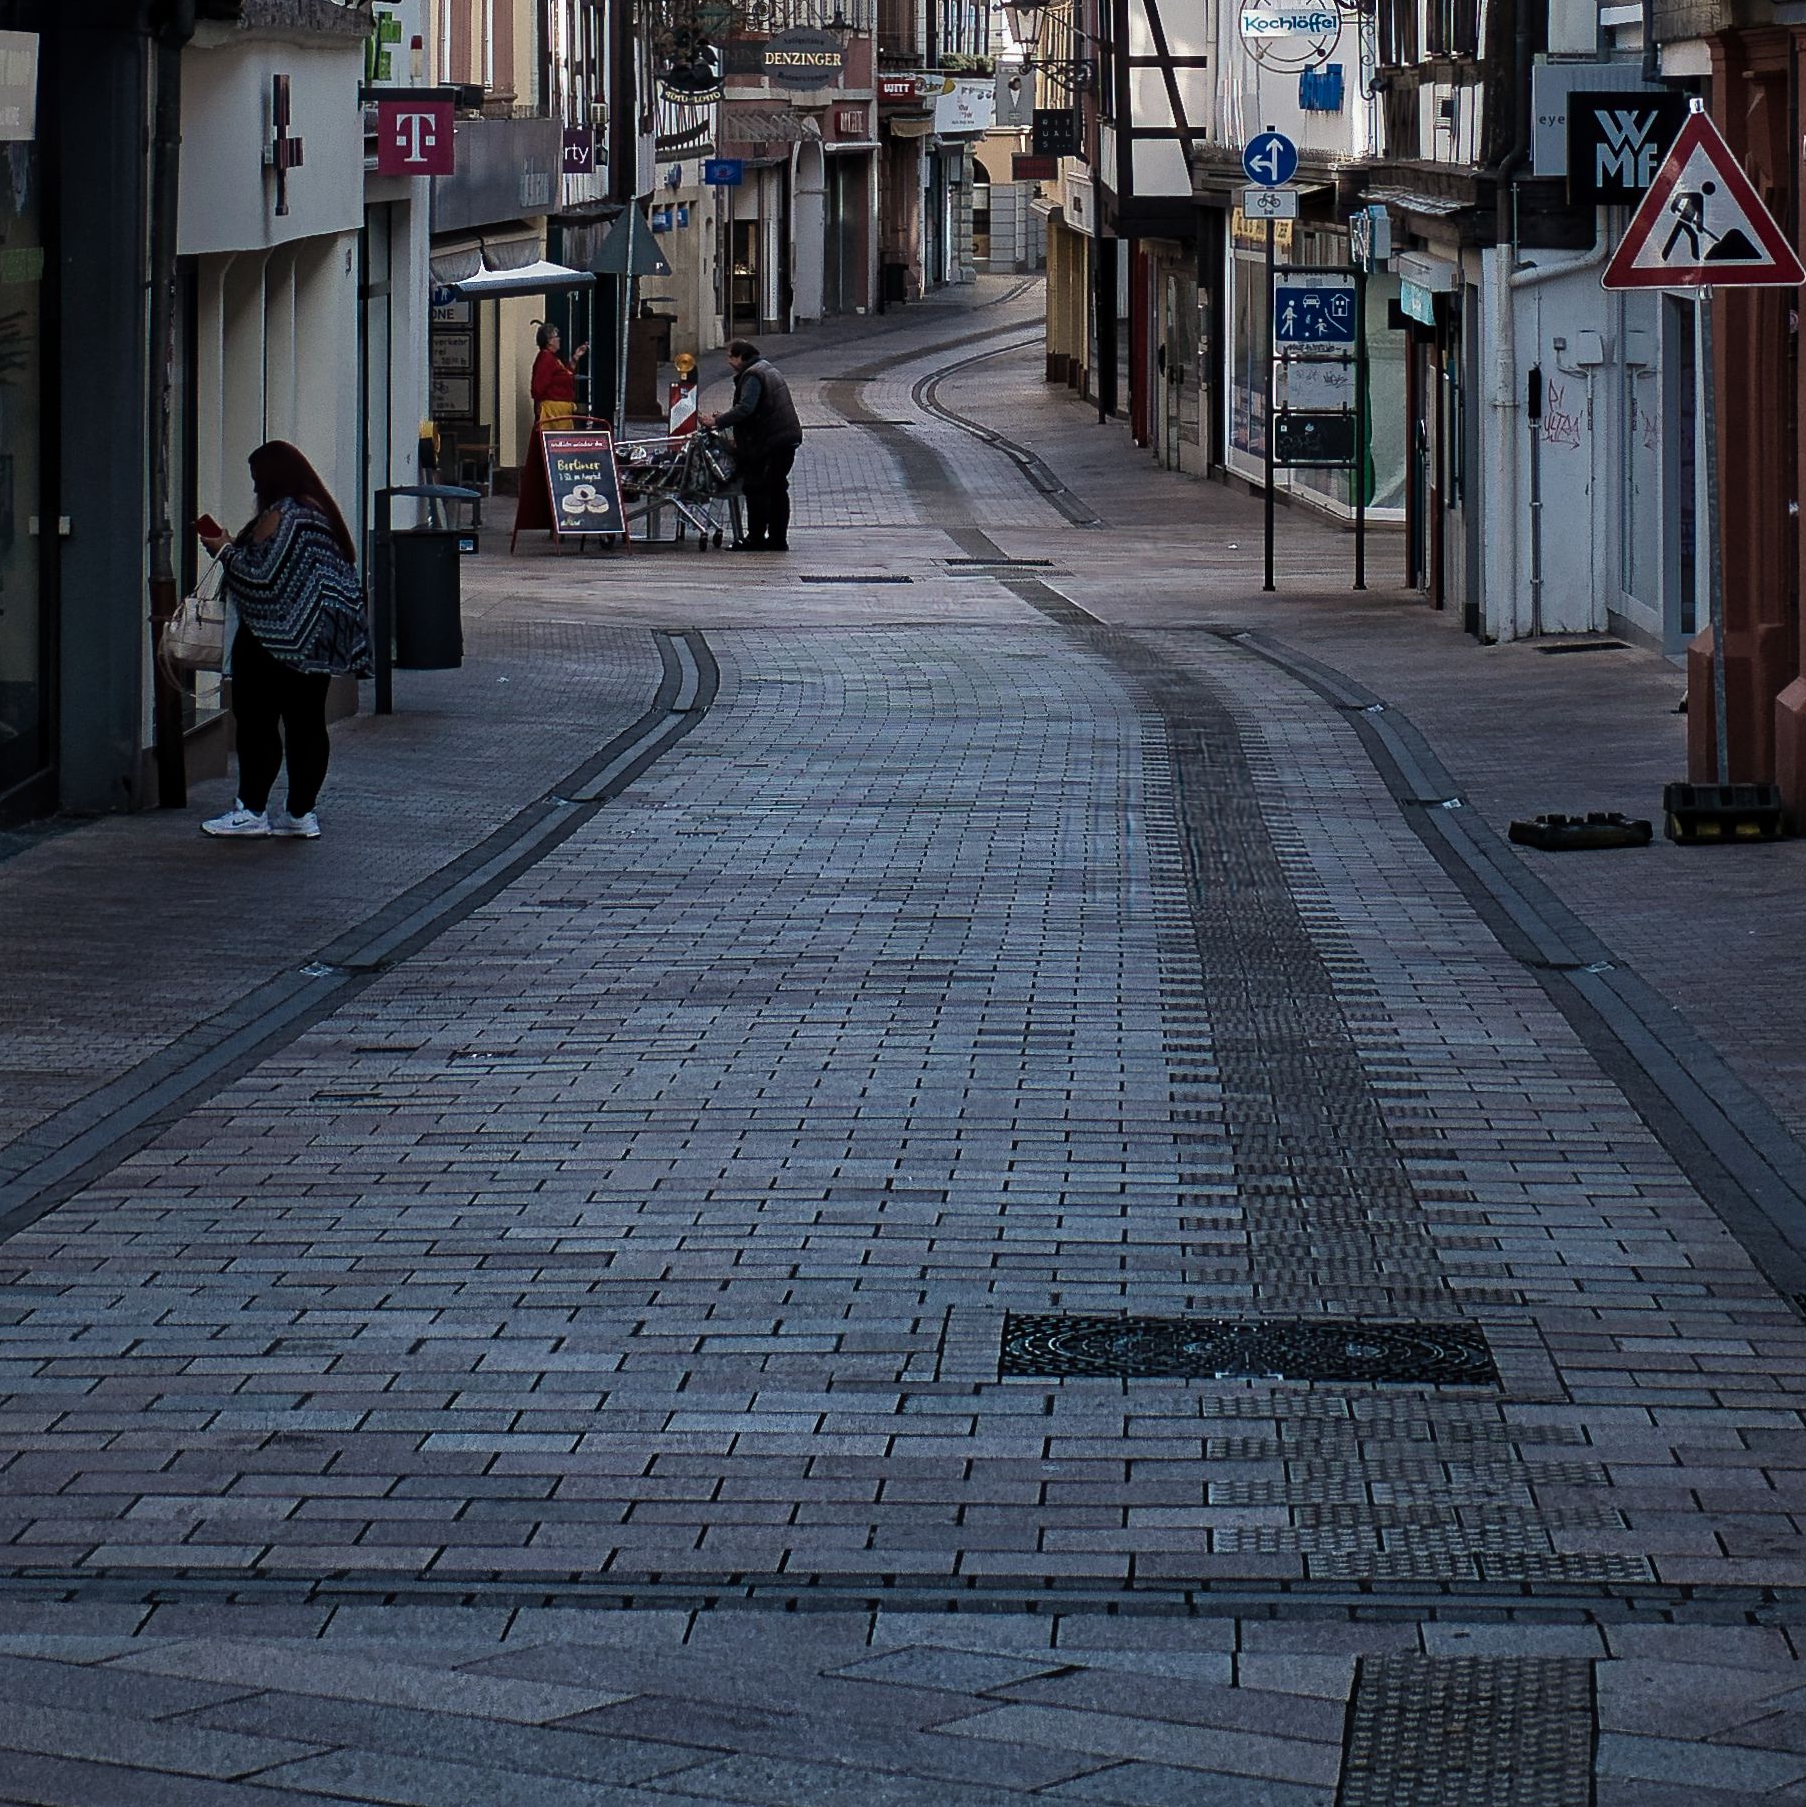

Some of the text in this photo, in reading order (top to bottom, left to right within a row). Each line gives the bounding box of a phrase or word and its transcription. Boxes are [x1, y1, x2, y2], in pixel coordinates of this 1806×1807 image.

[1243, 12, 1338, 33] Kochlöffel
[764, 51, 842, 67] DENZINGER
[557, 458, 601, 471] Berliner
